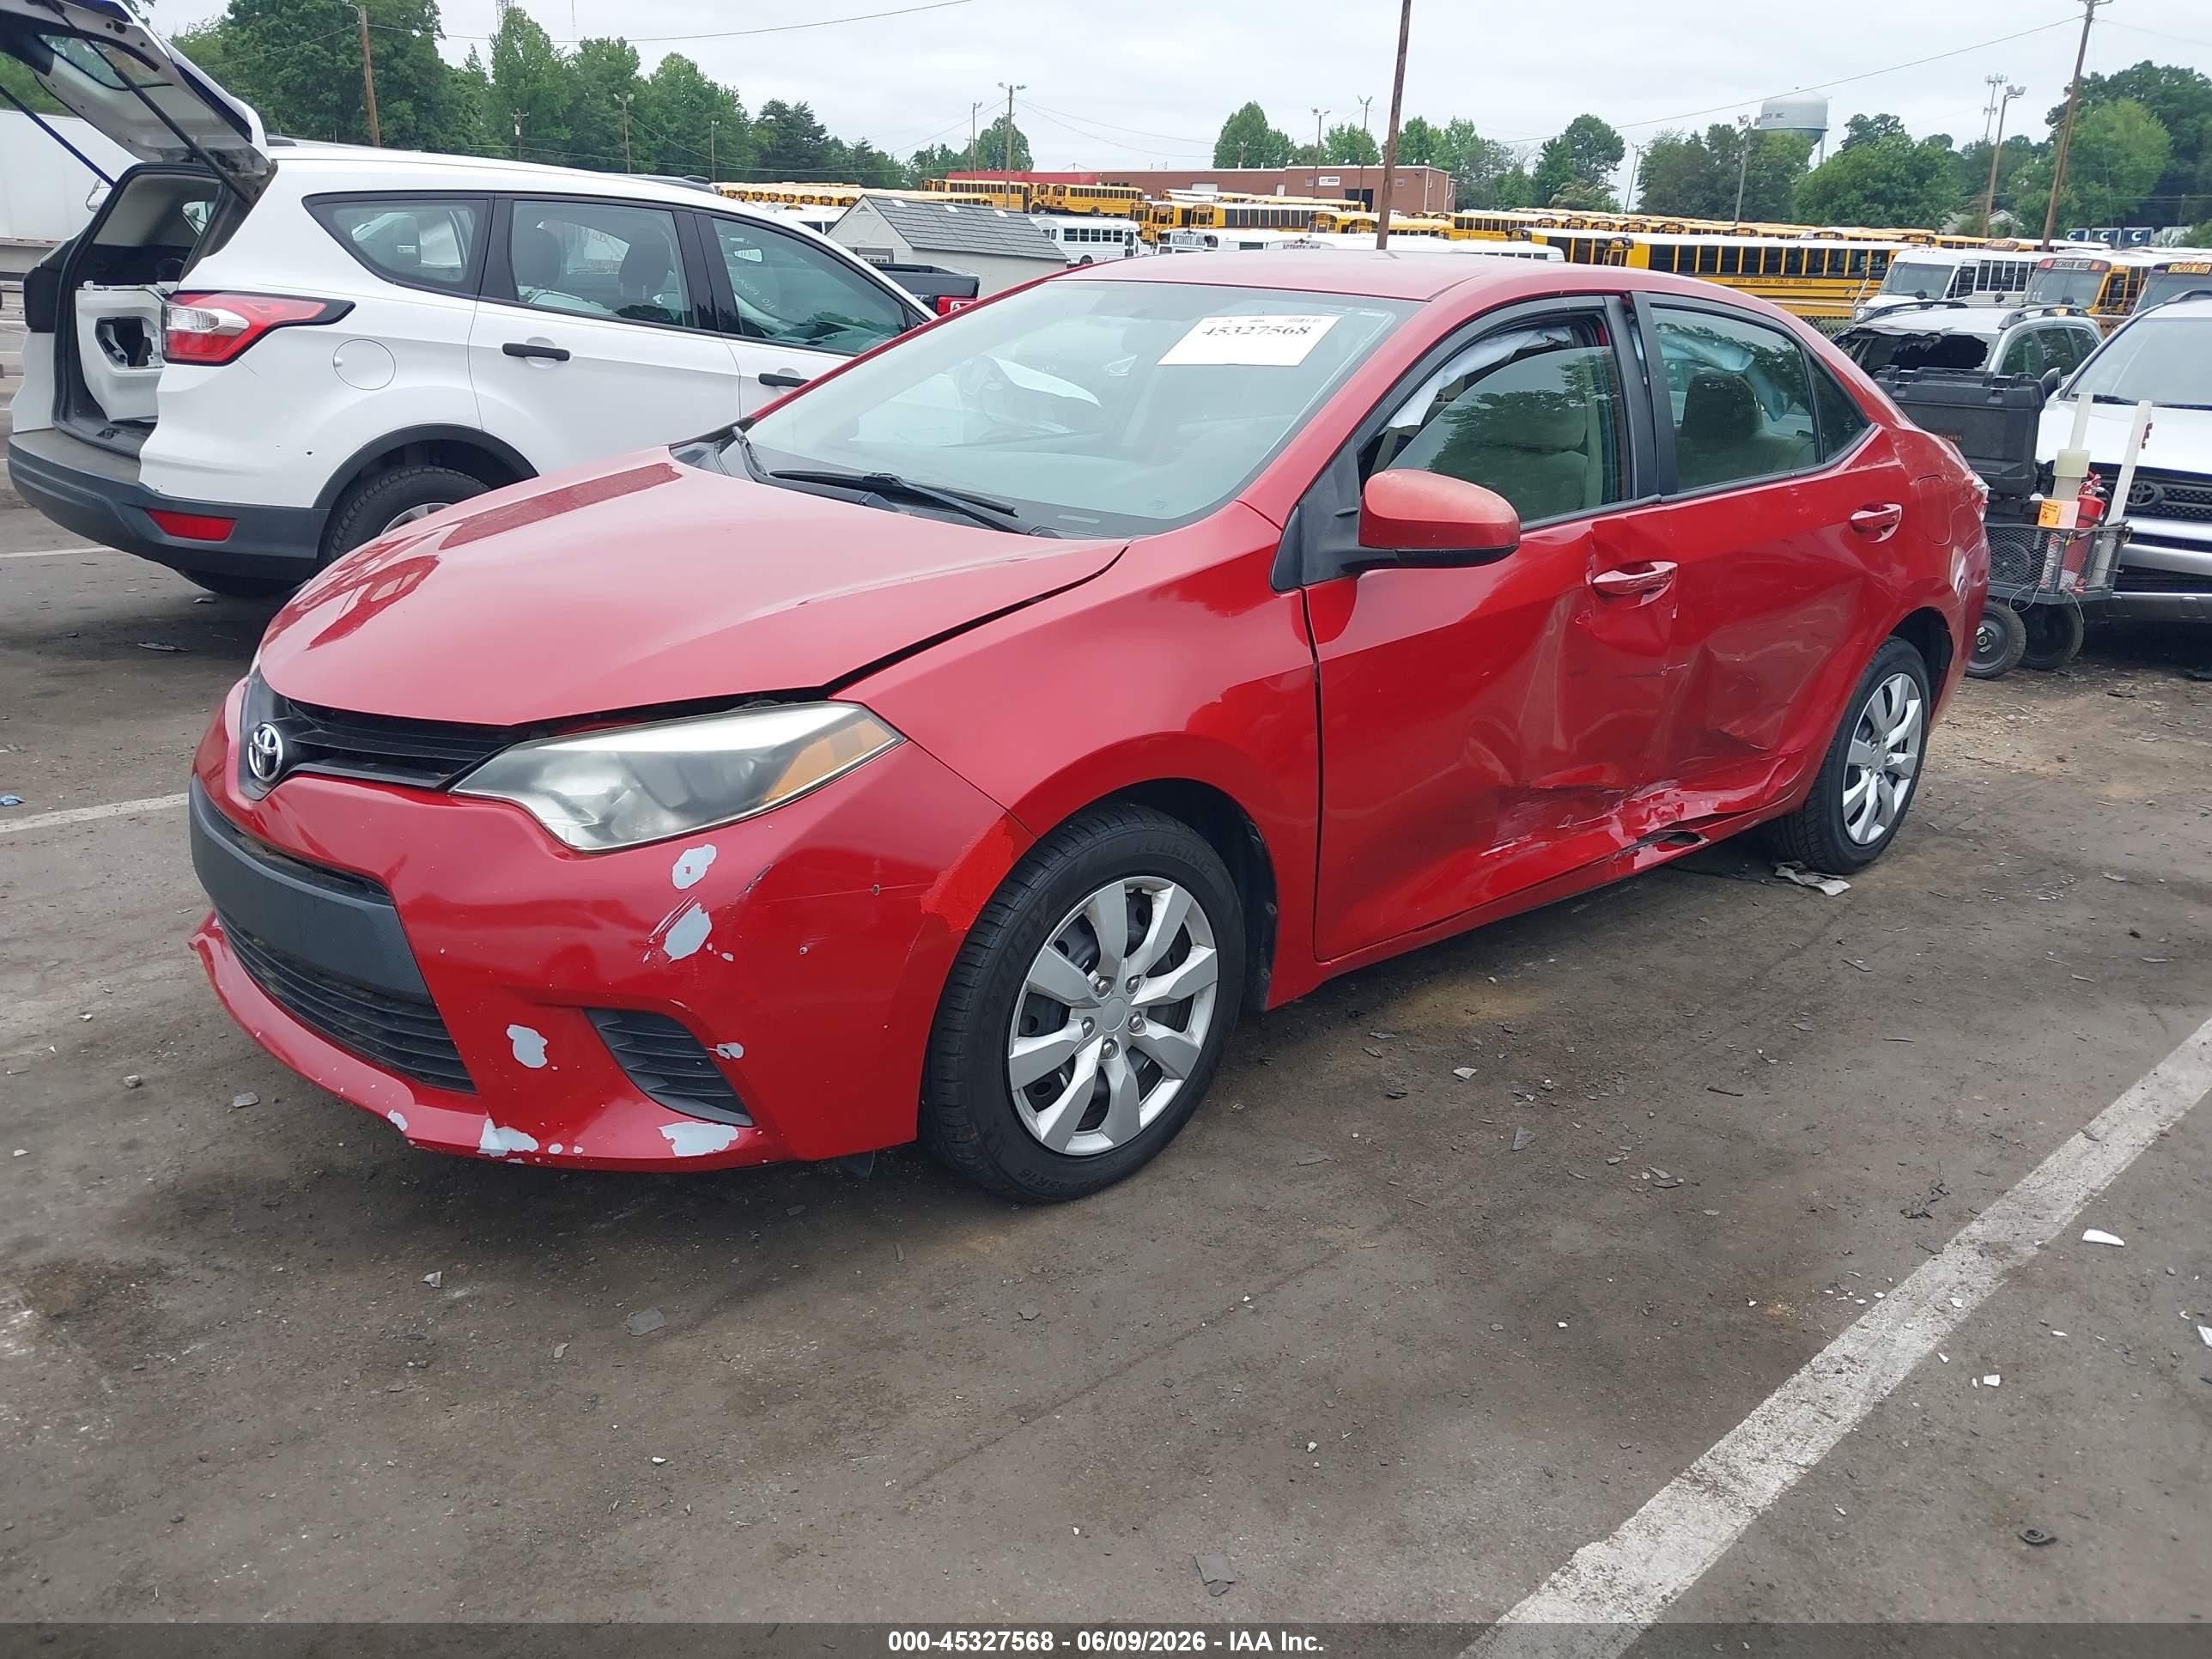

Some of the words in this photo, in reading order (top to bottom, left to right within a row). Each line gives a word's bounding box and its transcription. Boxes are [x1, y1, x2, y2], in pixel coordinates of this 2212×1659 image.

[1171, 234, 1193, 245] ACTIVITY
[1195, 235, 1206, 246] BUS
[2067, 232, 2077, 241] C
[2099, 232, 2110, 241] C
[2131, 231, 2142, 241] C
[2053, 260, 2075, 269] SCHOOL
[2076, 261, 2089, 270] BUS
[1202, 325, 1311, 336] 45327568
